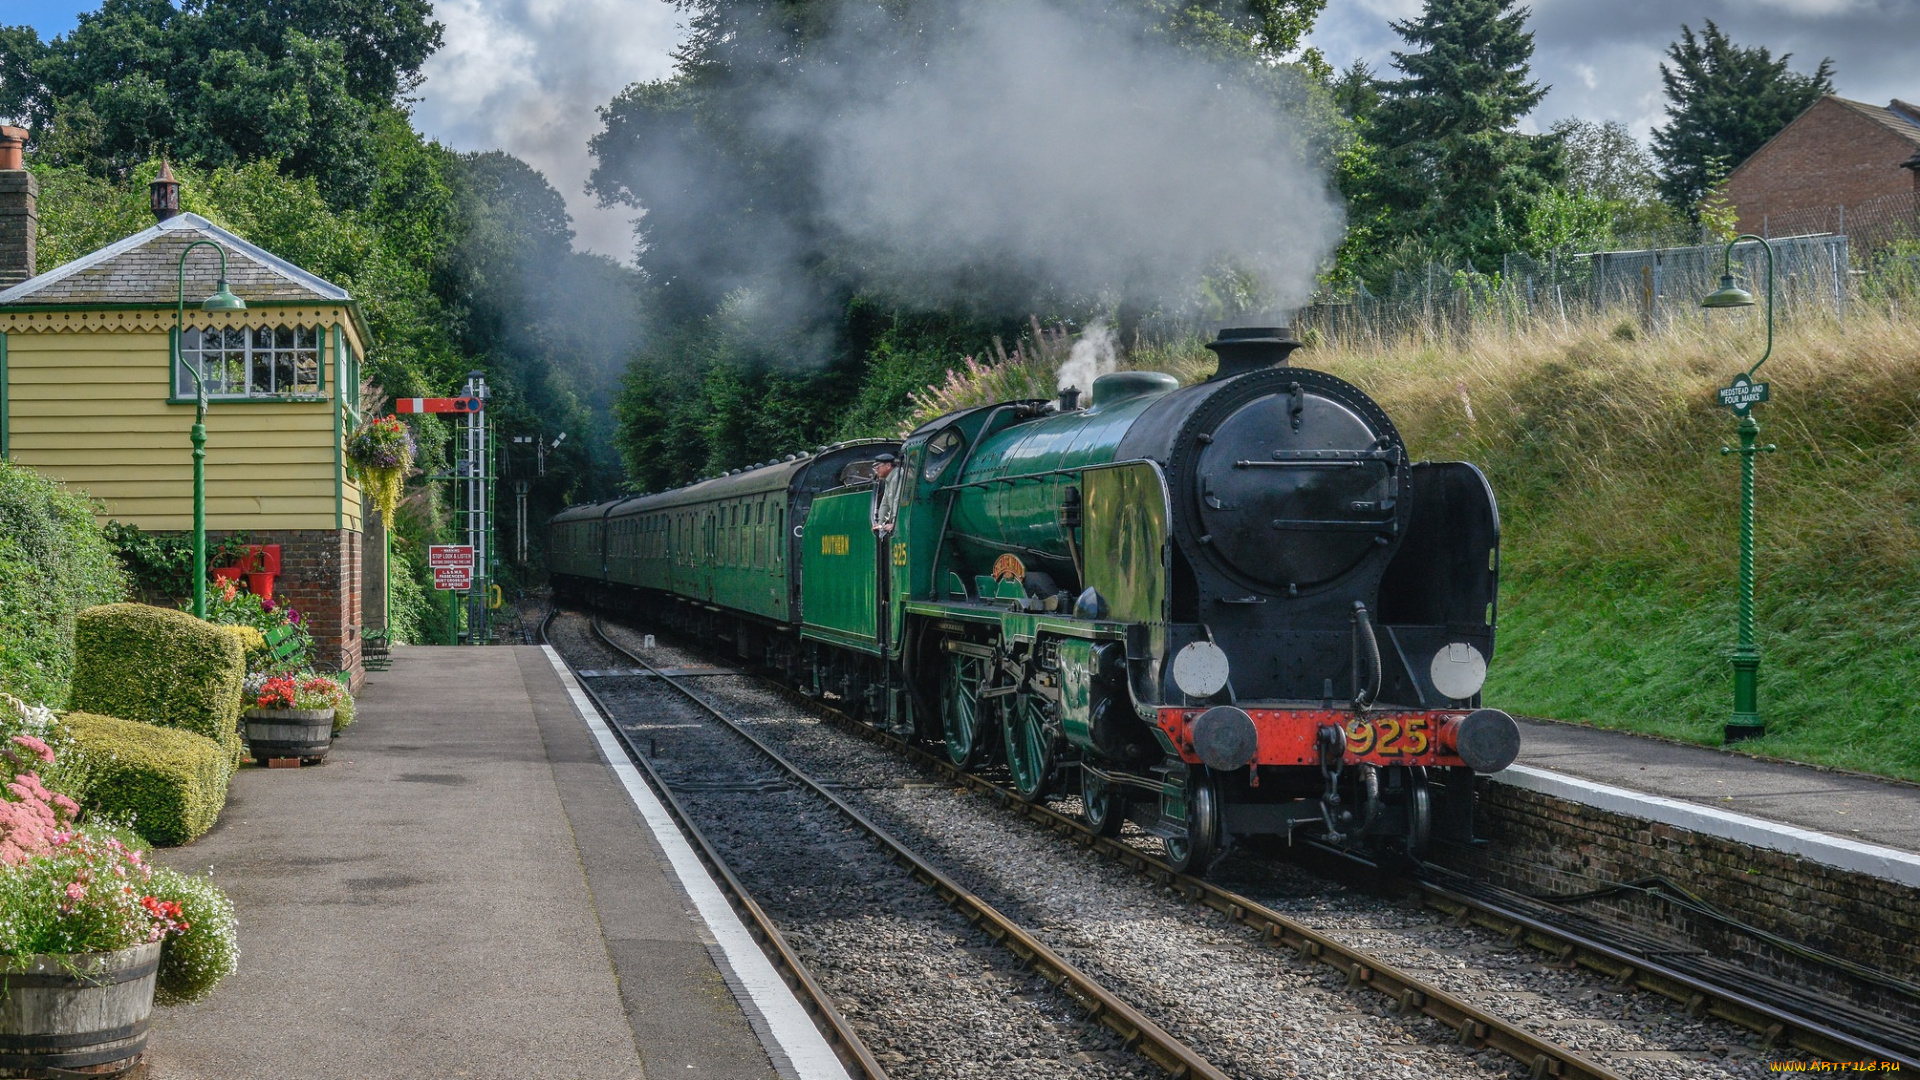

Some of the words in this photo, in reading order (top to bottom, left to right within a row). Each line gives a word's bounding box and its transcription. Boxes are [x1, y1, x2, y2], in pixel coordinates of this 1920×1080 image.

[1720, 387, 1749, 397] MEDSTEAD
[1751, 384, 1764, 393] AND
[1724, 396, 1739, 404] FOUR
[1741, 393, 1760, 402] MARKS
[821, 534, 850, 555] SOUTHERN
[893, 542, 907, 566] 925
[1346, 718, 1429, 757] 925
